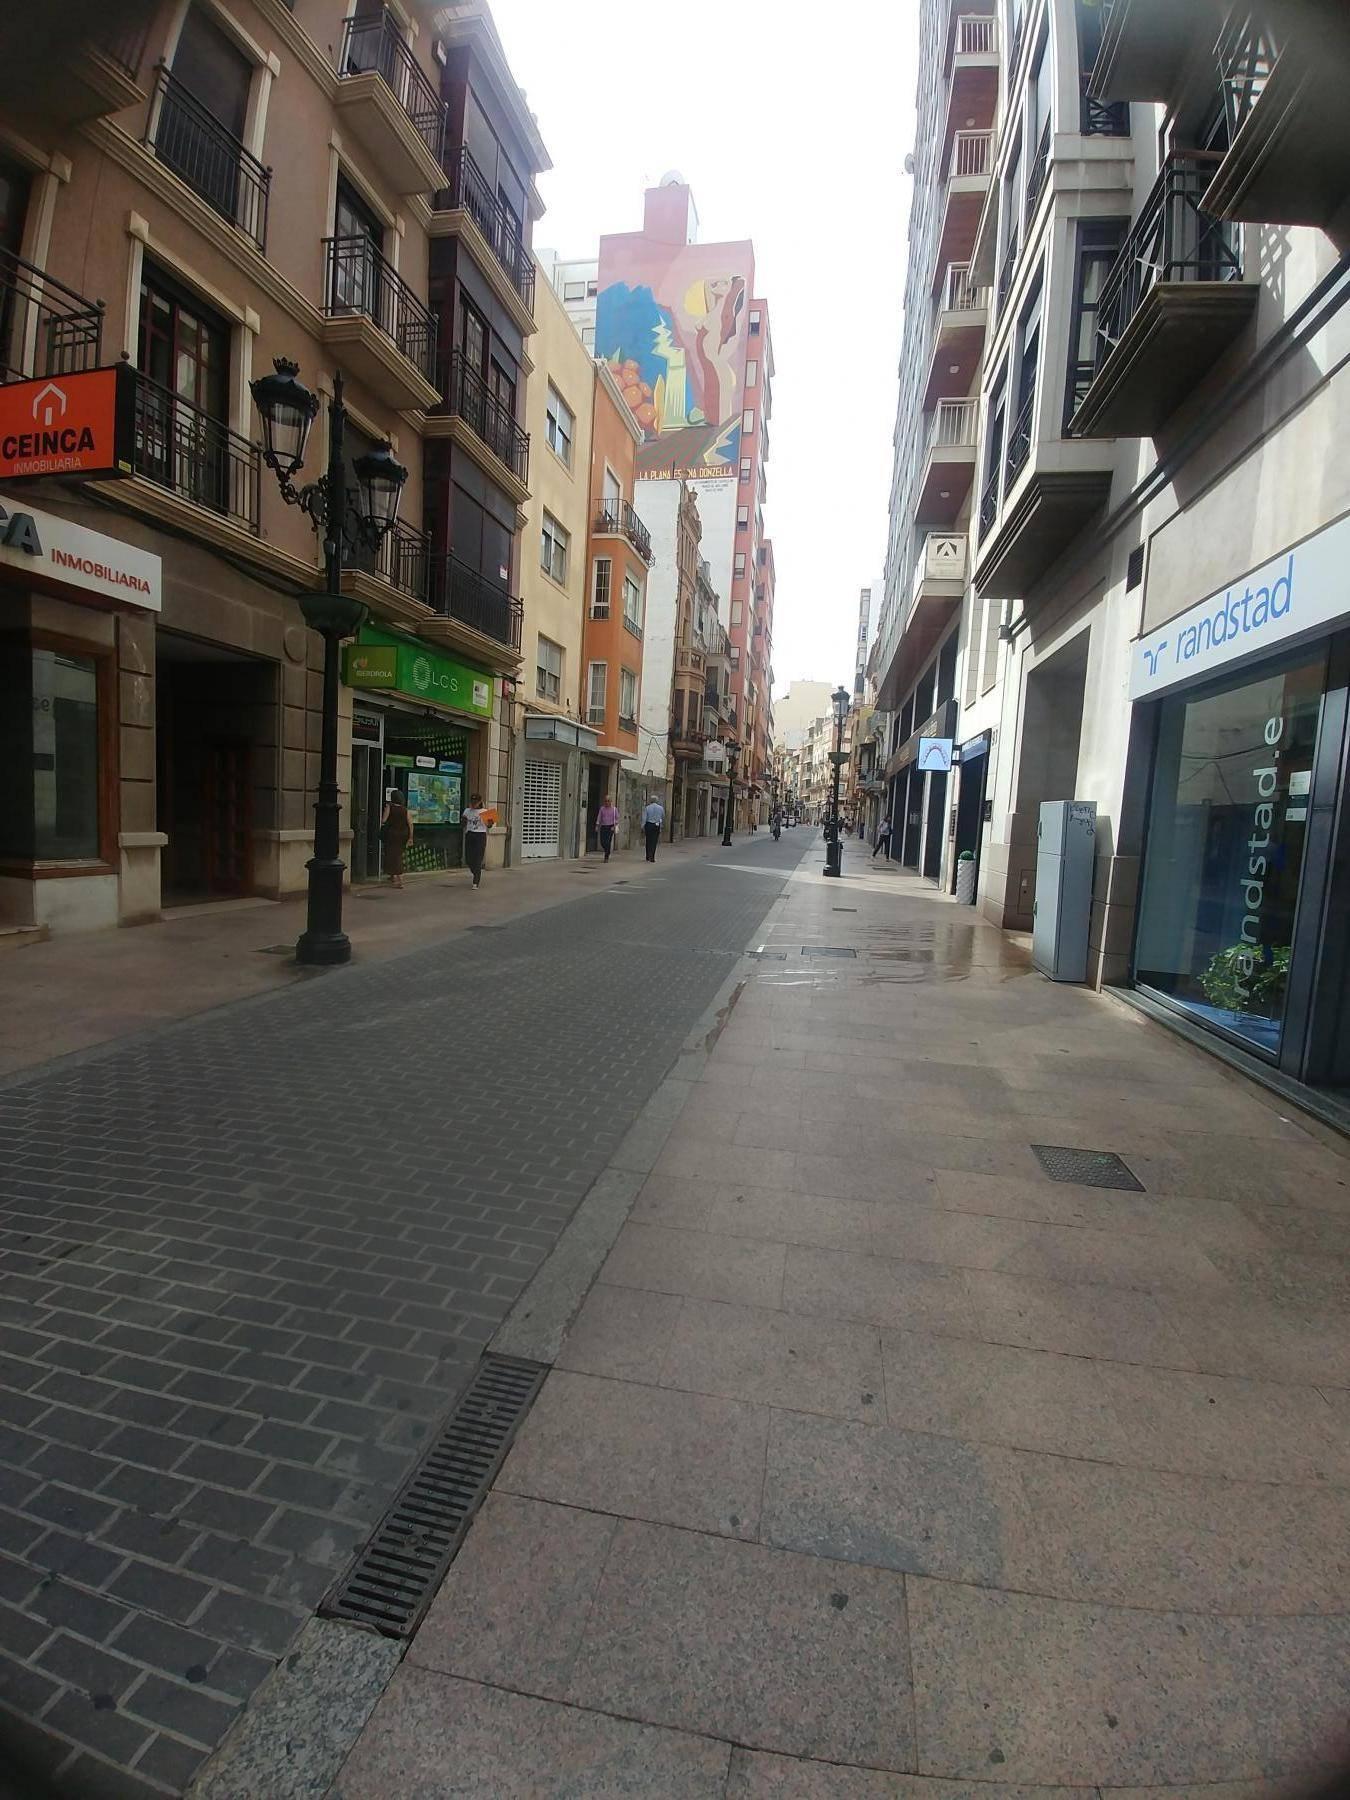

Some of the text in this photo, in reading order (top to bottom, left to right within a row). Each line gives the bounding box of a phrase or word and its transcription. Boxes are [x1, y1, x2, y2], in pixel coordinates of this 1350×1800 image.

[2, 427, 95, 460] CEINCA
[13, 457, 82, 474] INMOBILIARIA
[639, 472, 648, 480] LA
[650, 470, 671, 480] PLANA
[699, 467, 733, 478] DONZELLA
[51, 548, 151, 595] INMOBILIARIA
[1175, 554, 1294, 664] randstad
[432, 671, 458, 692] LCS
